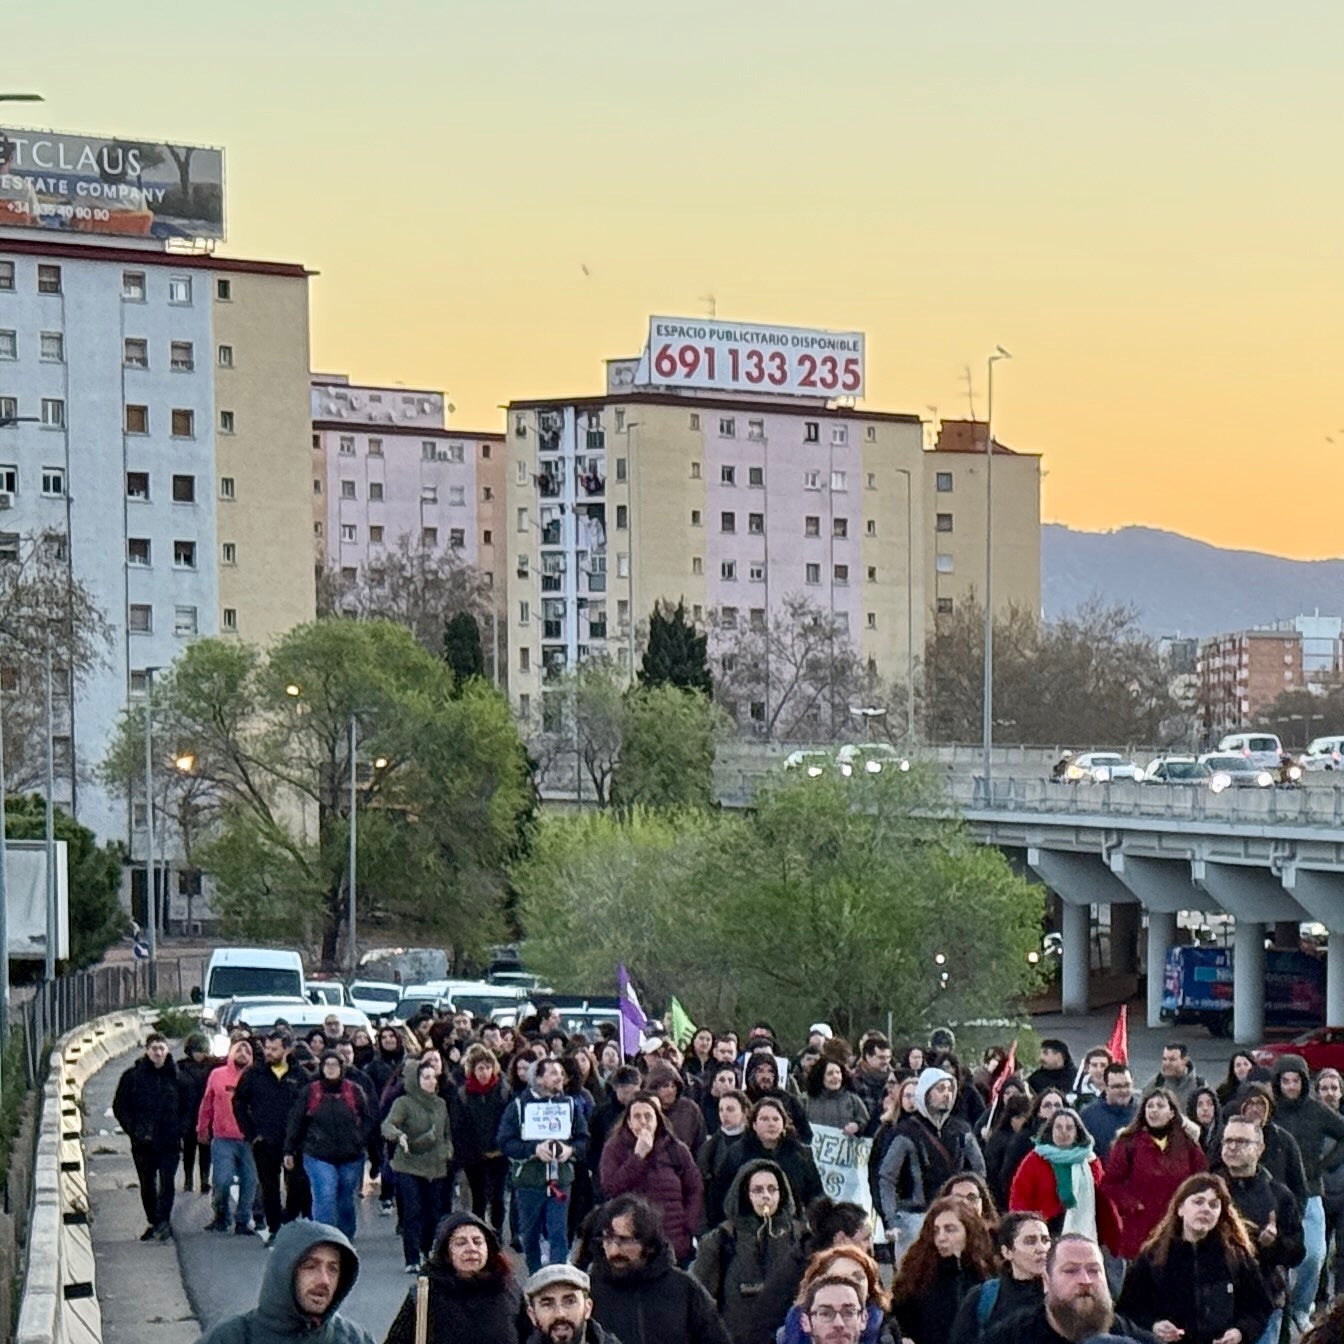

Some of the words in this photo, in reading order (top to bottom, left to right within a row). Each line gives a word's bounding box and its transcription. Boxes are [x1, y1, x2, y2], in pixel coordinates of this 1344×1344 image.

[1, 174, 68, 194] ESTATE
[77, 182, 166, 204] COMPANY
[657, 325, 706, 340] ESPACIO
[709, 328, 789, 347] PUBLICITARIO
[792, 336, 860, 352] DISPONIBLE
[655, 344, 715, 381] 691
[728, 348, 788, 386] 133
[797, 353, 861, 391] 235
